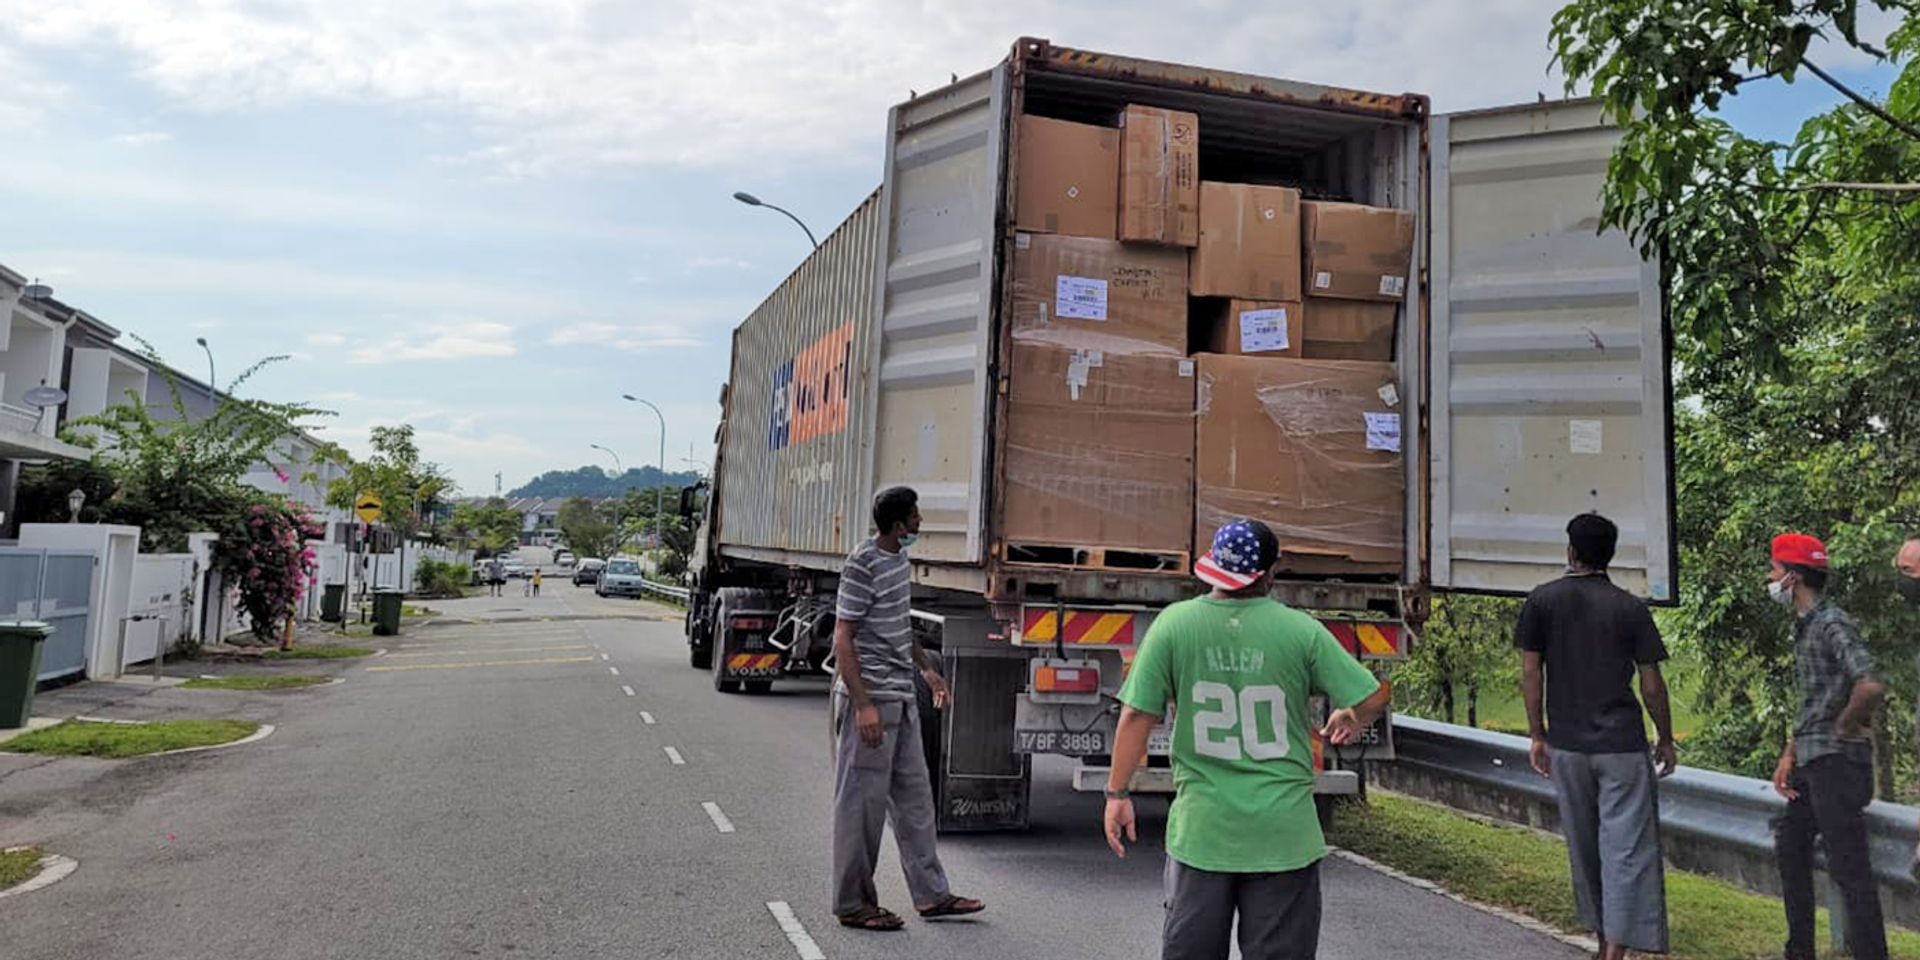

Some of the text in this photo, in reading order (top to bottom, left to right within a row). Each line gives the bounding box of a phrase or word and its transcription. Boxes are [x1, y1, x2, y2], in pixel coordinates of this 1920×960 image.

[729, 667, 779, 677] VOLVO
[1206, 645, 1265, 673] ALLEN
[1192, 680, 1291, 761] 20
